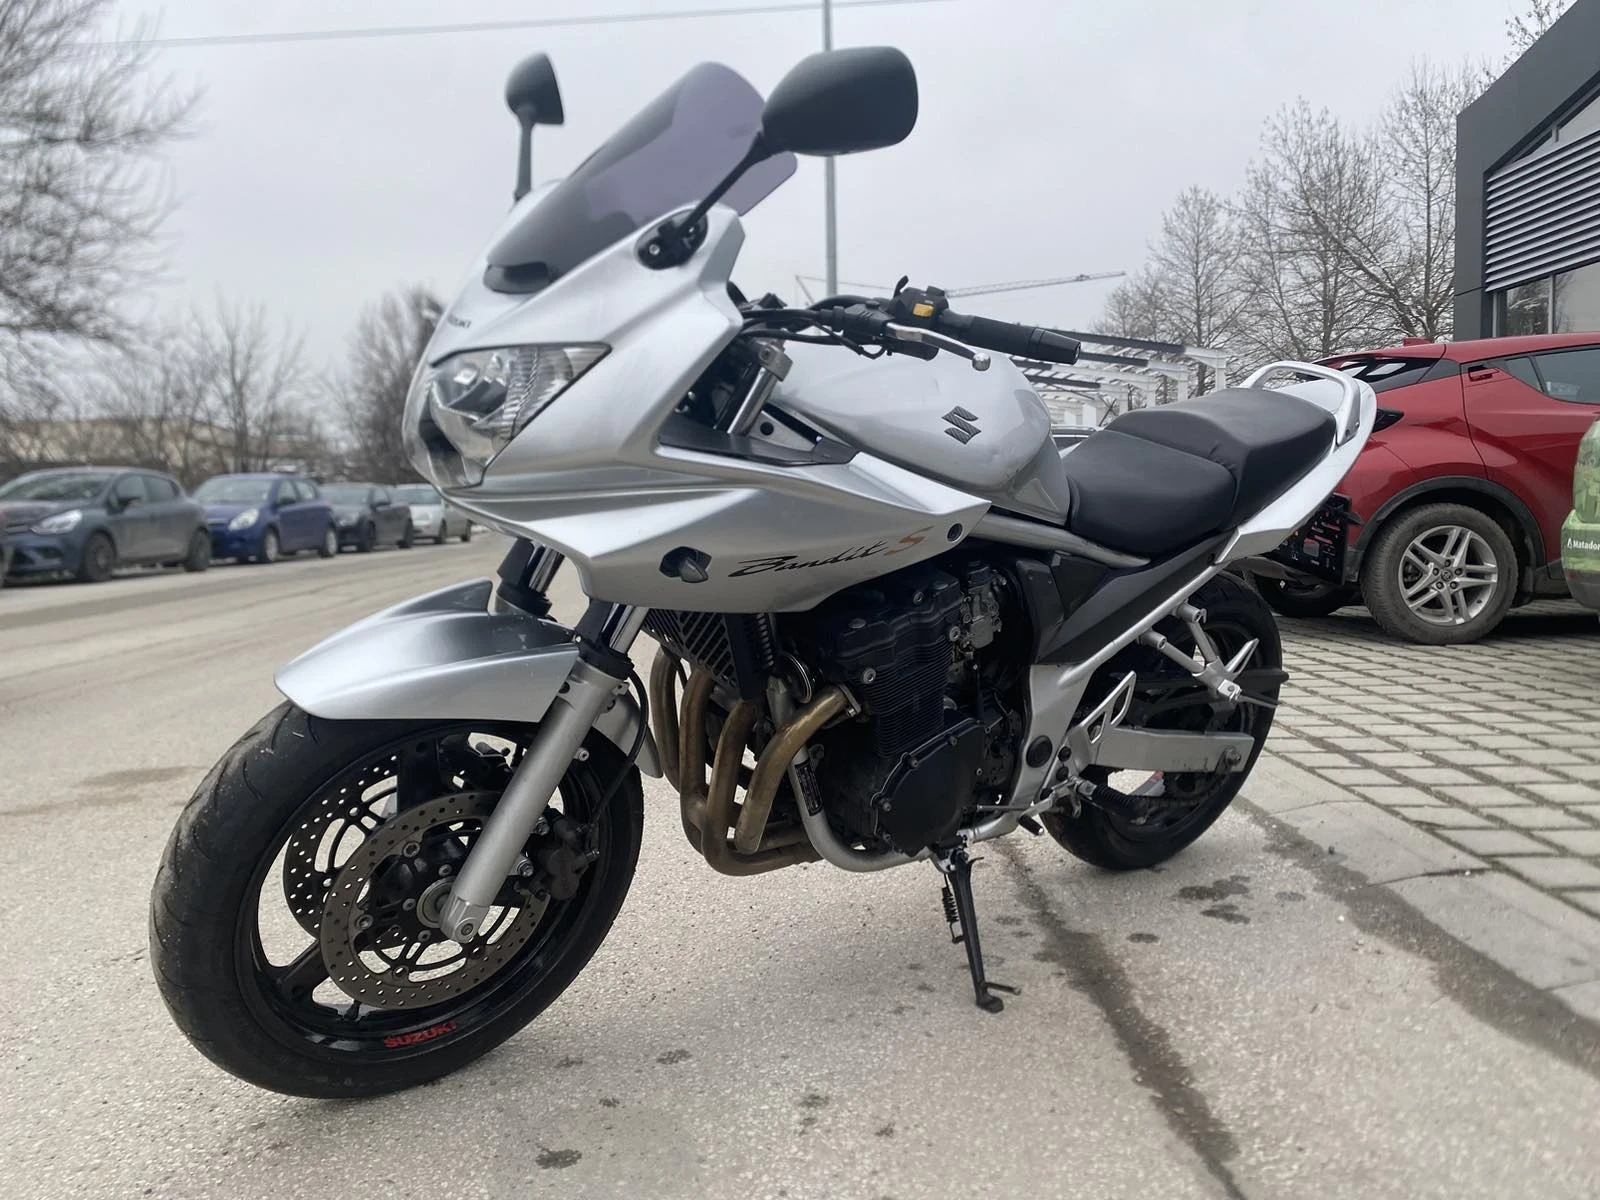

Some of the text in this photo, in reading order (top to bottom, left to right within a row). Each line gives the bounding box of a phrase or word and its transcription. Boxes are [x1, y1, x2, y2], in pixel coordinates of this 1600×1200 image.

[727, 525, 934, 578] Bandit S
[384, 1020, 457, 1047] SUZUKI
